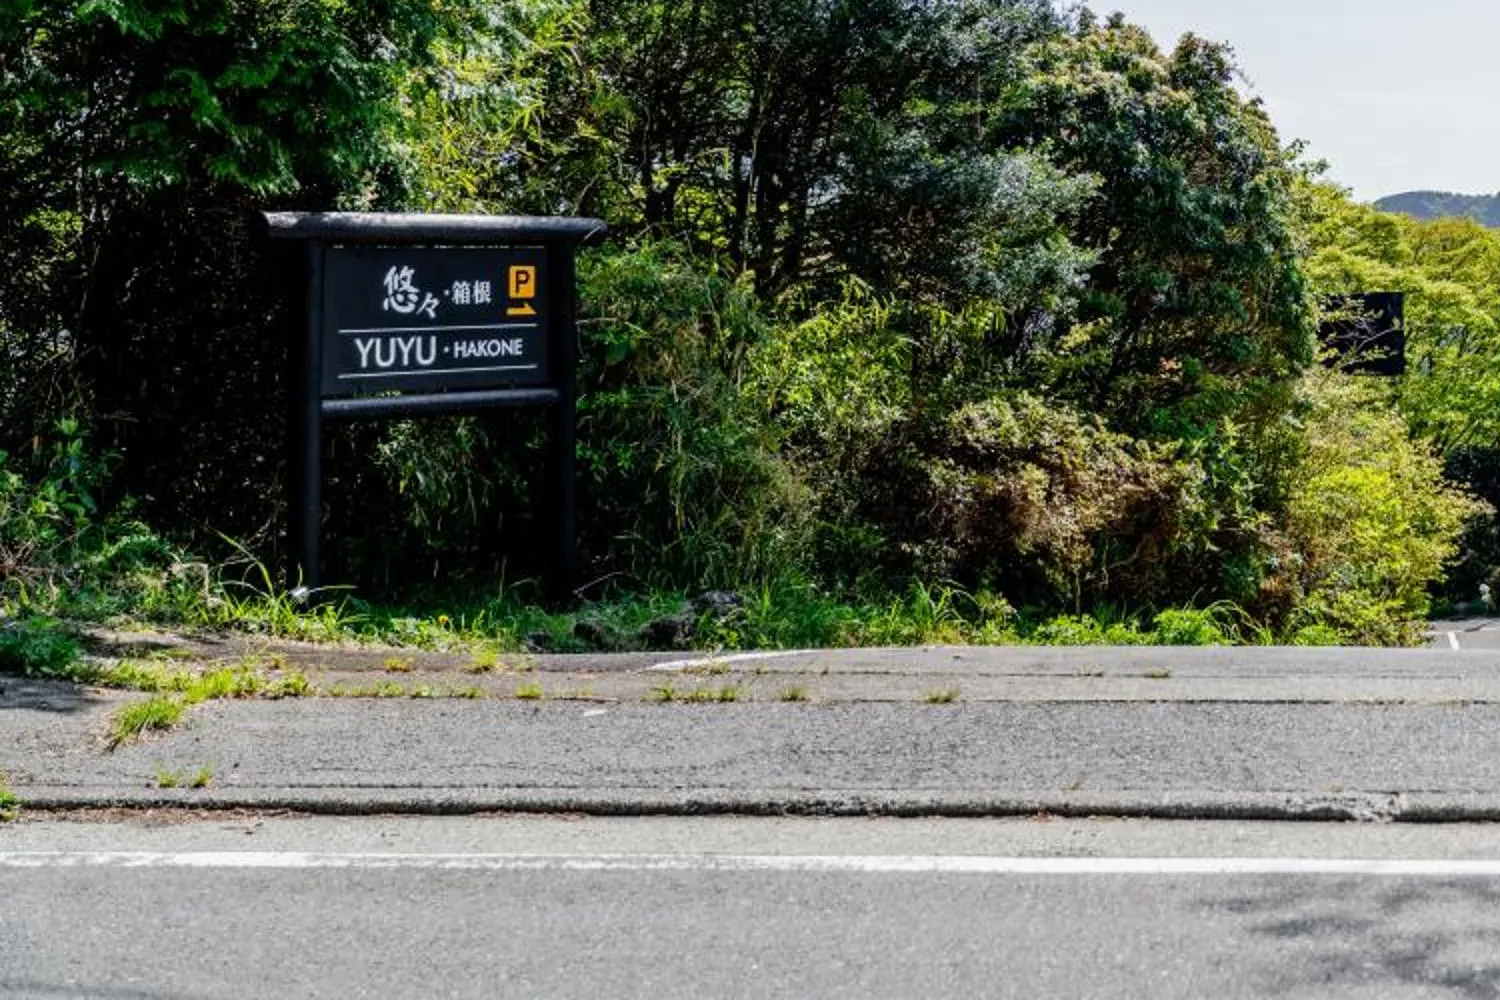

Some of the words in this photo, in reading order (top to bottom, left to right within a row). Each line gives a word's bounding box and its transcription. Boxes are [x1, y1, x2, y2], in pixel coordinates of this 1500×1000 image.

[515, 270, 529, 294] P
[354, 335, 437, 369] YUYU
[453, 337, 524, 359] HAKONE
